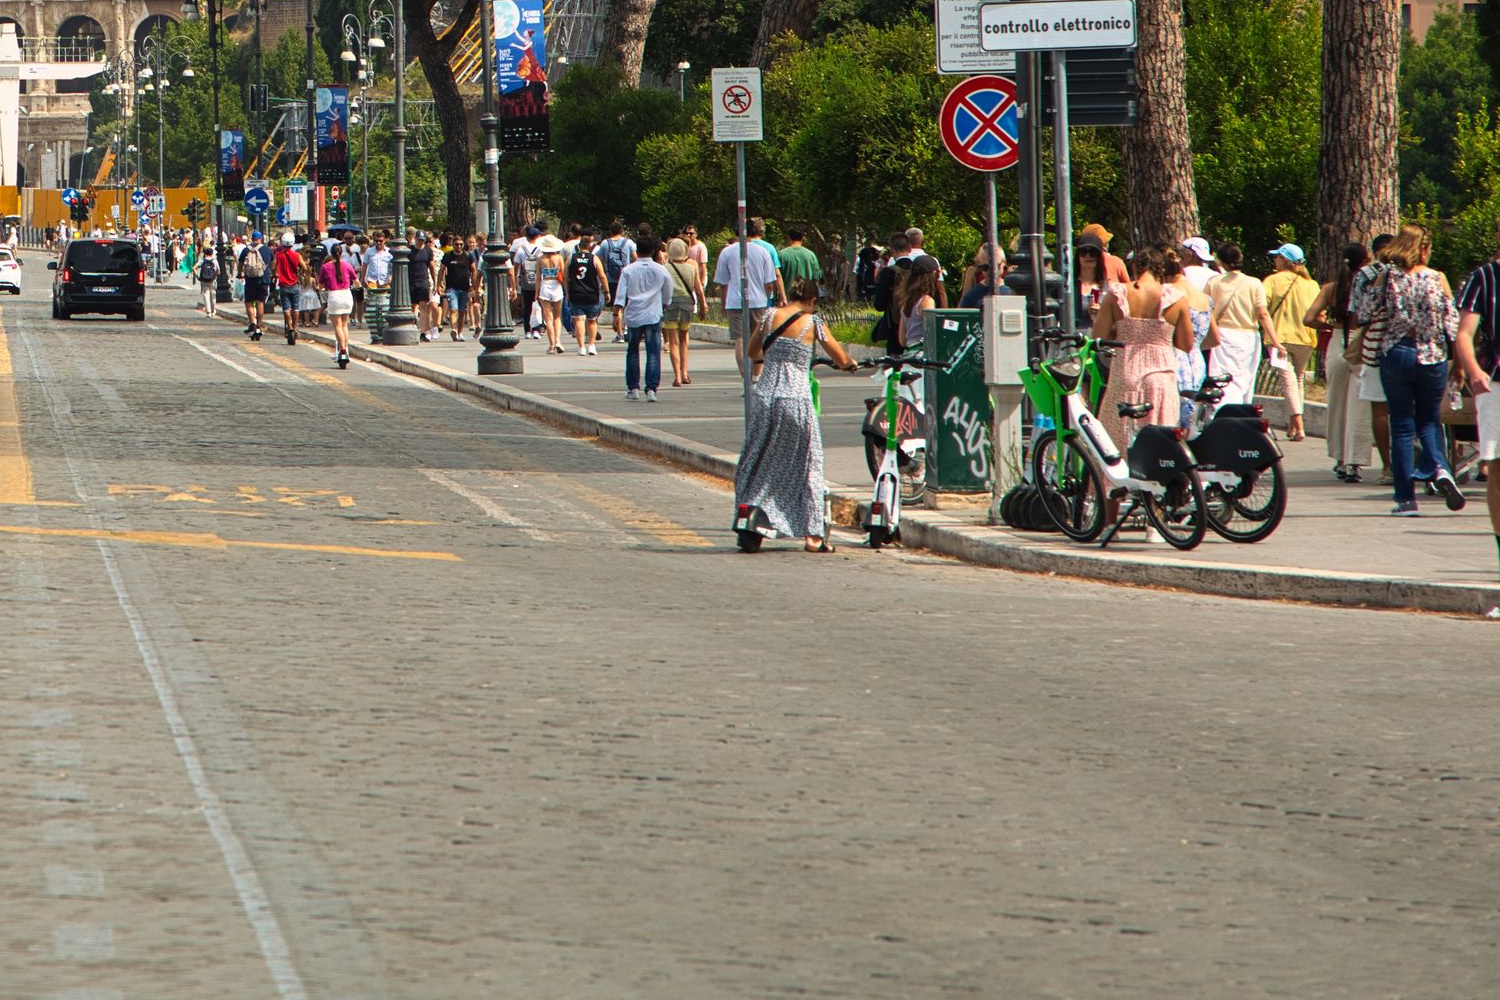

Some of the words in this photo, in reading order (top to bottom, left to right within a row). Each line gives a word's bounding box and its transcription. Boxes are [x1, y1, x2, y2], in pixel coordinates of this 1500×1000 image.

[984, 18, 1049, 34] controllo
[1053, 16, 1131, 32] elettronico
[576, 266, 587, 280] 3
